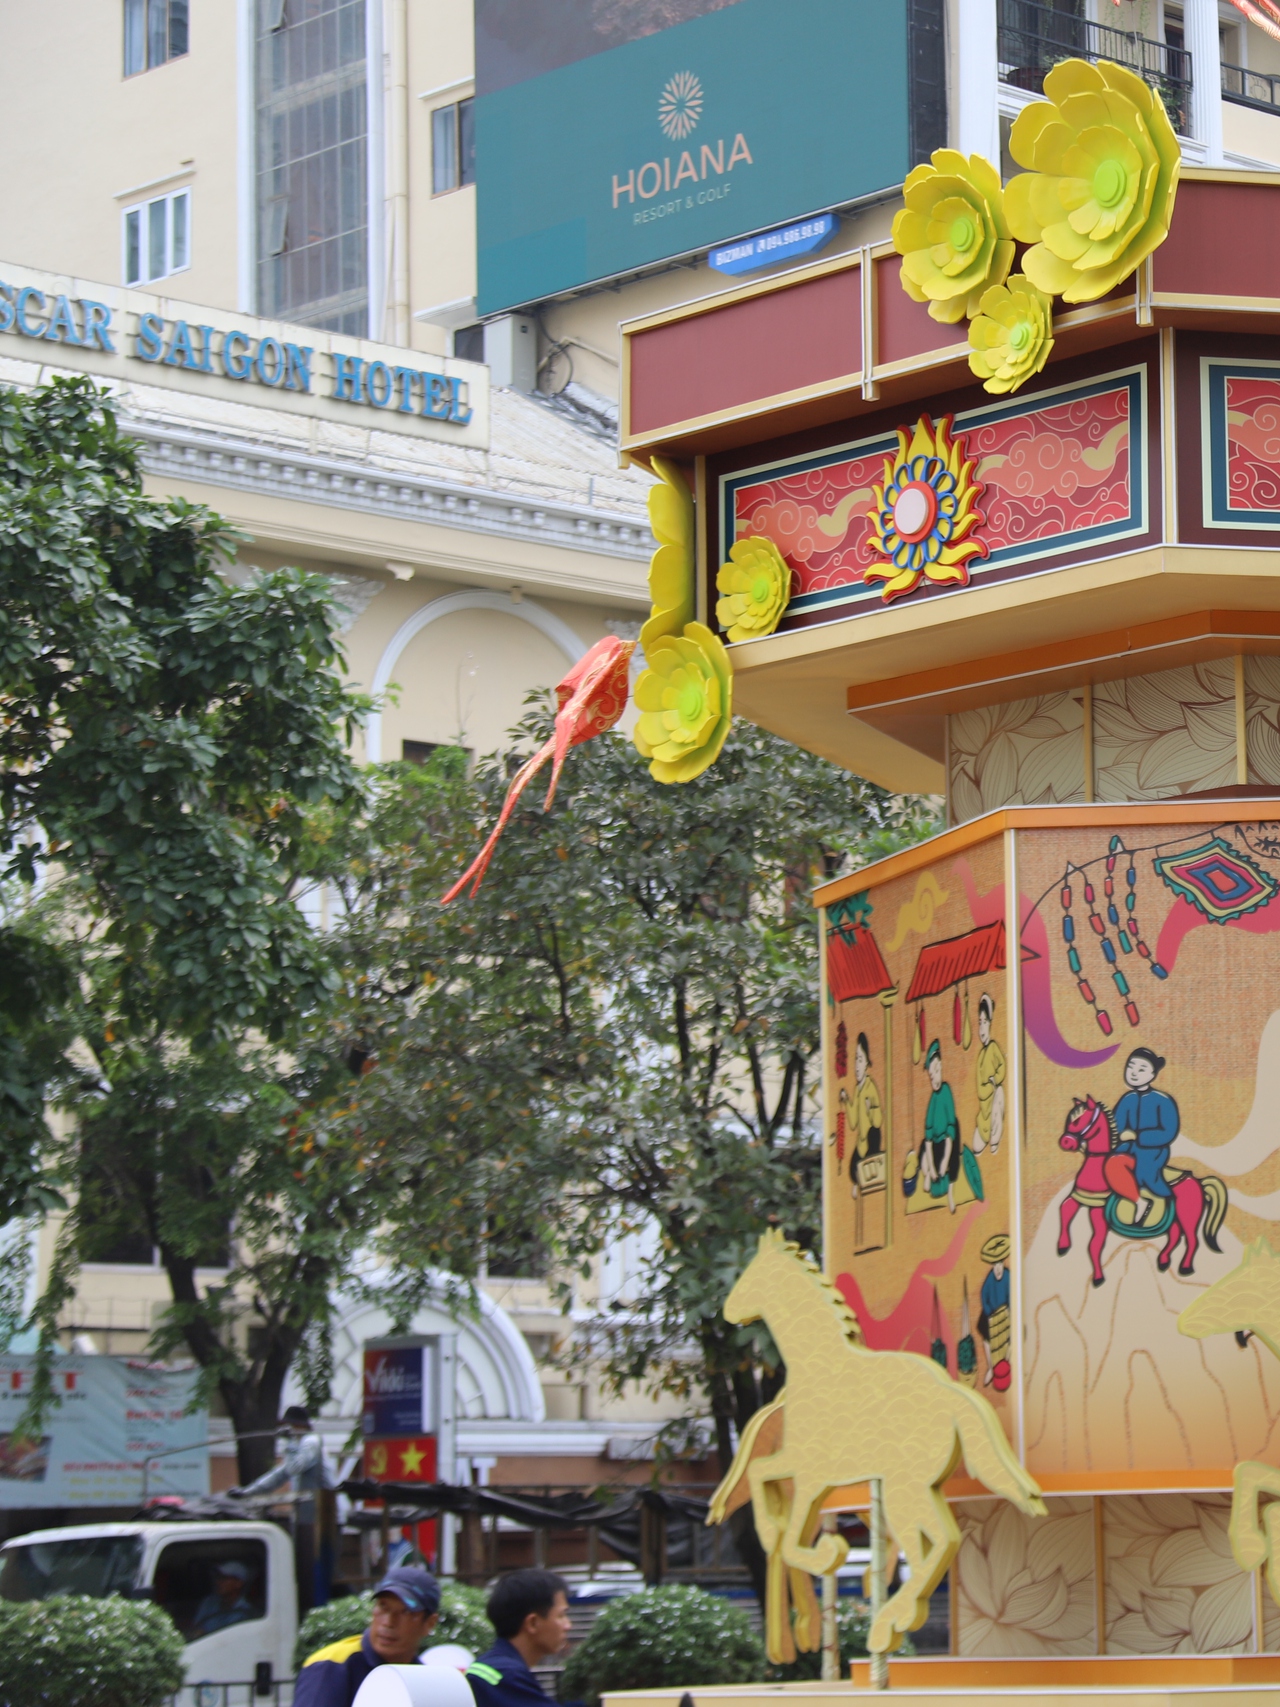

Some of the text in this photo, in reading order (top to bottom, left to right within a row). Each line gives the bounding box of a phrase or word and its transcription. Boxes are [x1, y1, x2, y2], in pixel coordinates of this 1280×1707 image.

[611, 132, 754, 209] HOIANA
[633, 183, 732, 226] RESORT & GOLF
[715, 243, 754, 266] BIZMAN
[136, 312, 315, 392] SAIGON
[331, 352, 474, 426] HOTEL
